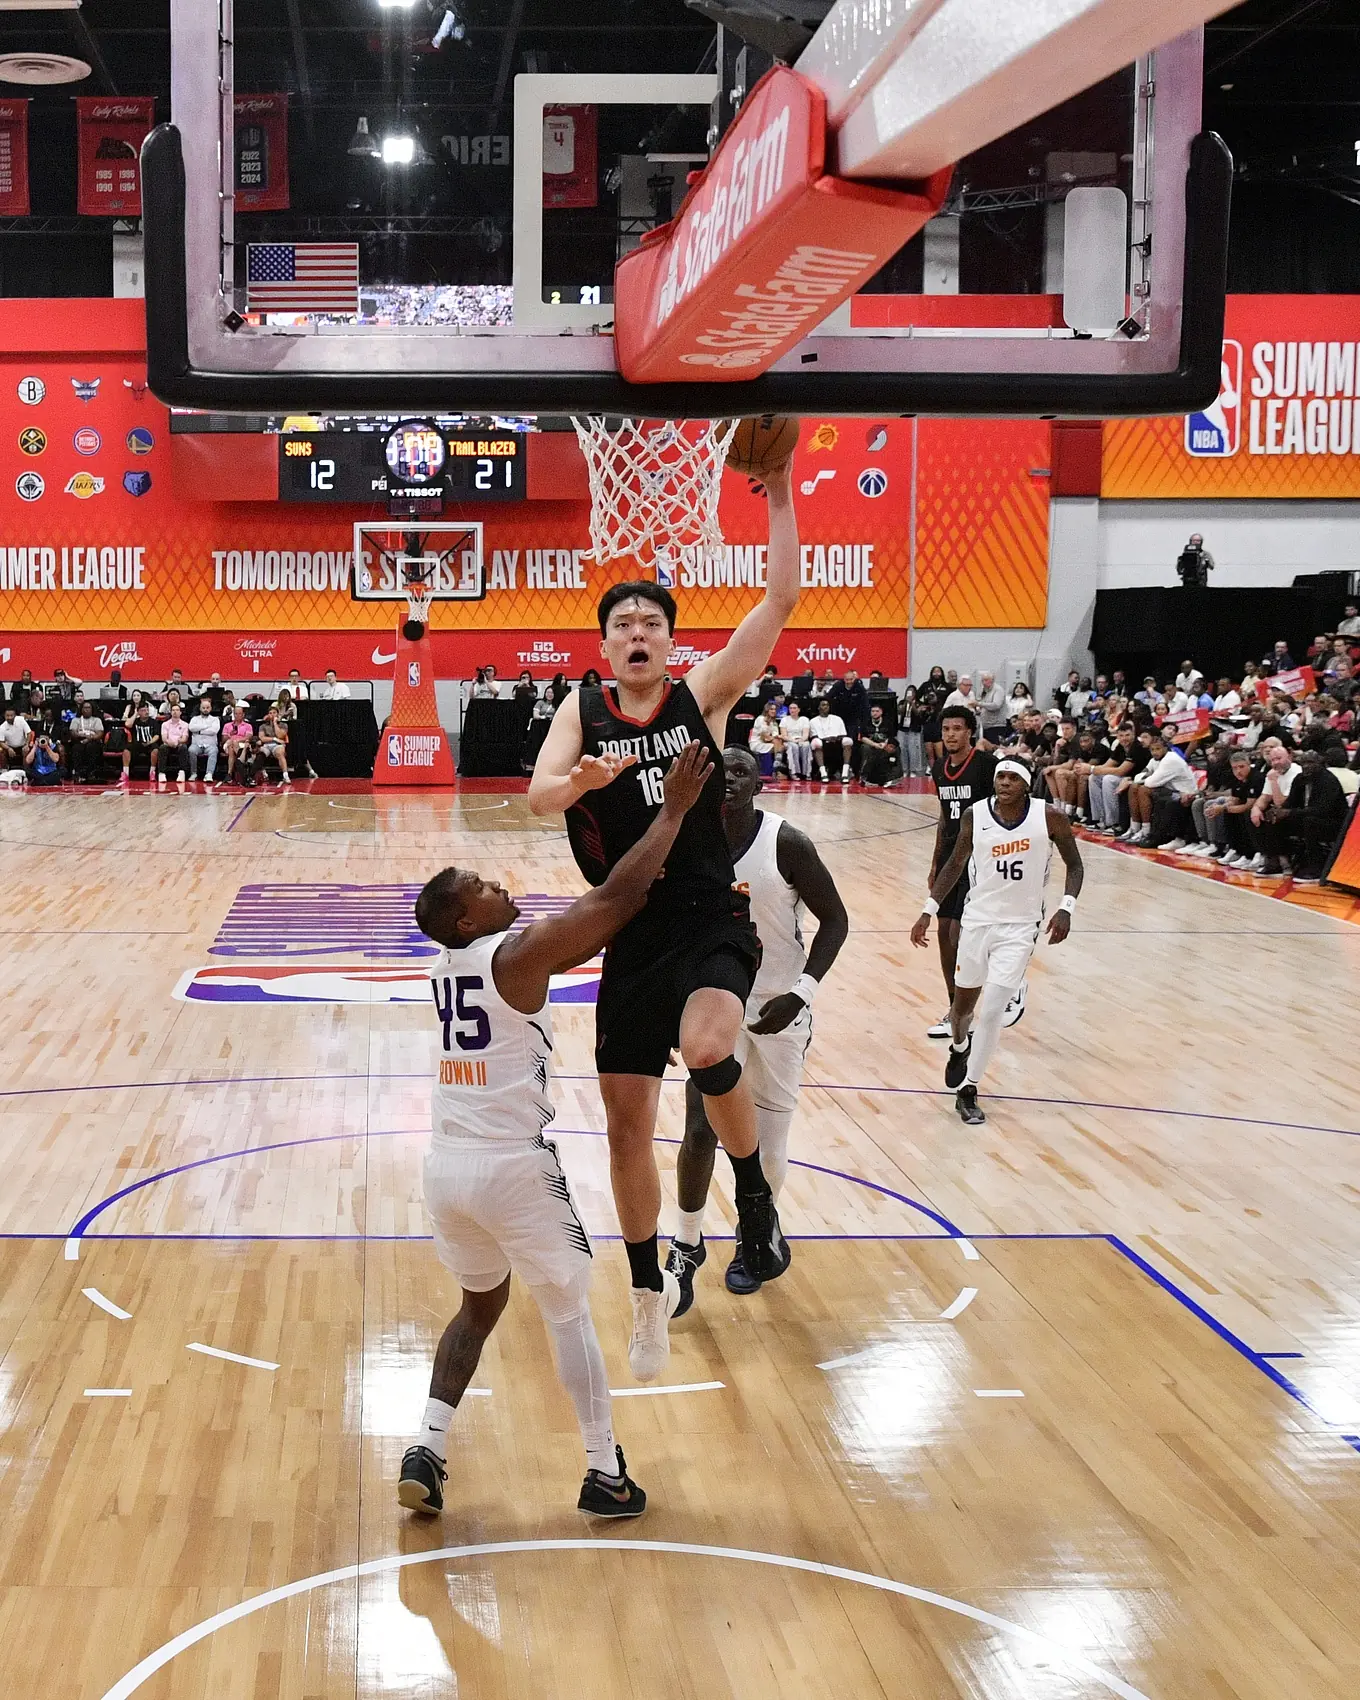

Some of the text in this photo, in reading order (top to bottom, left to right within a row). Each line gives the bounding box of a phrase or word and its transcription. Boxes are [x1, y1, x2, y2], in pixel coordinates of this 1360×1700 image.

[555, 132, 564, 146] 4
[241, 162, 261, 171] 2023
[241, 174, 261, 183] 2024
[1251, 342, 1360, 397] SUMM
[28, 381, 36, 400] B
[285, 441, 312, 456] SUNS
[448, 441, 516, 455] TRAIL BLAZER
[1192, 430, 1219, 449] NBA
[311, 460, 335, 490] 12
[475, 459, 512, 490] 21
[404, 488, 443, 497] TISSOT
[61, 547, 145, 590] LEAGUE
[526, 549, 587, 589] HERE
[680, 544, 874, 588] SUMME EAGUE
[94, 643, 143, 668] Vegas
[240, 650, 273, 658] ULTRA
[517, 652, 571, 662] TISSOT
[797, 643, 857, 664] xfinity
[404, 735, 440, 751] SUMMER
[403, 751, 434, 766] LEAGUE
[636, 767, 665, 806] 16
[939, 785, 971, 800] PORTLAND
[949, 801, 961, 819] 26
[996, 860, 1023, 881] 46
[431, 975, 491, 1051] 45
